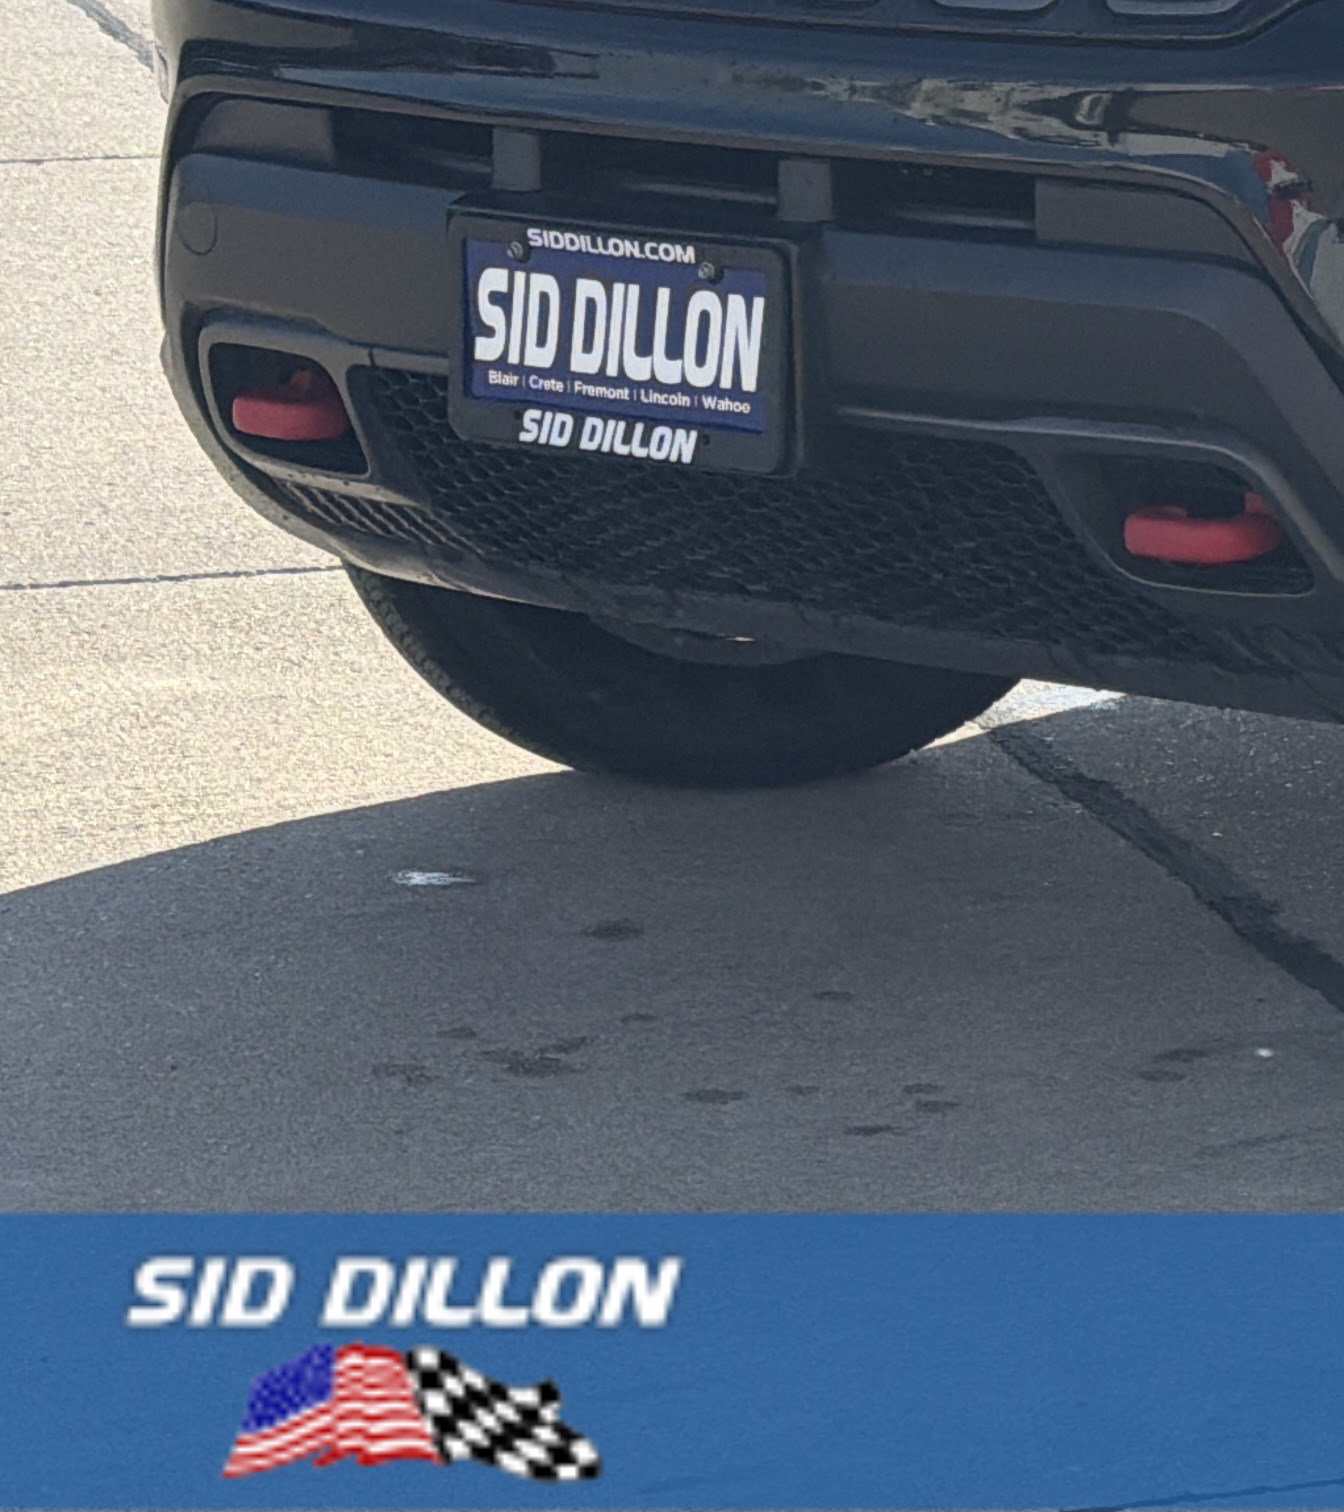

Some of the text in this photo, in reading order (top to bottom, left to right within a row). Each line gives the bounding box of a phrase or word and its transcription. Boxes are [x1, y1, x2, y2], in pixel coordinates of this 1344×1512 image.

[526, 228, 697, 264] SIDDILLON.COM
[474, 267, 765, 392] SID DILLON
[488, 370, 751, 414] Blair Crete Fremont Lincoln Wahoo
[519, 409, 698, 464] SID DILLON
